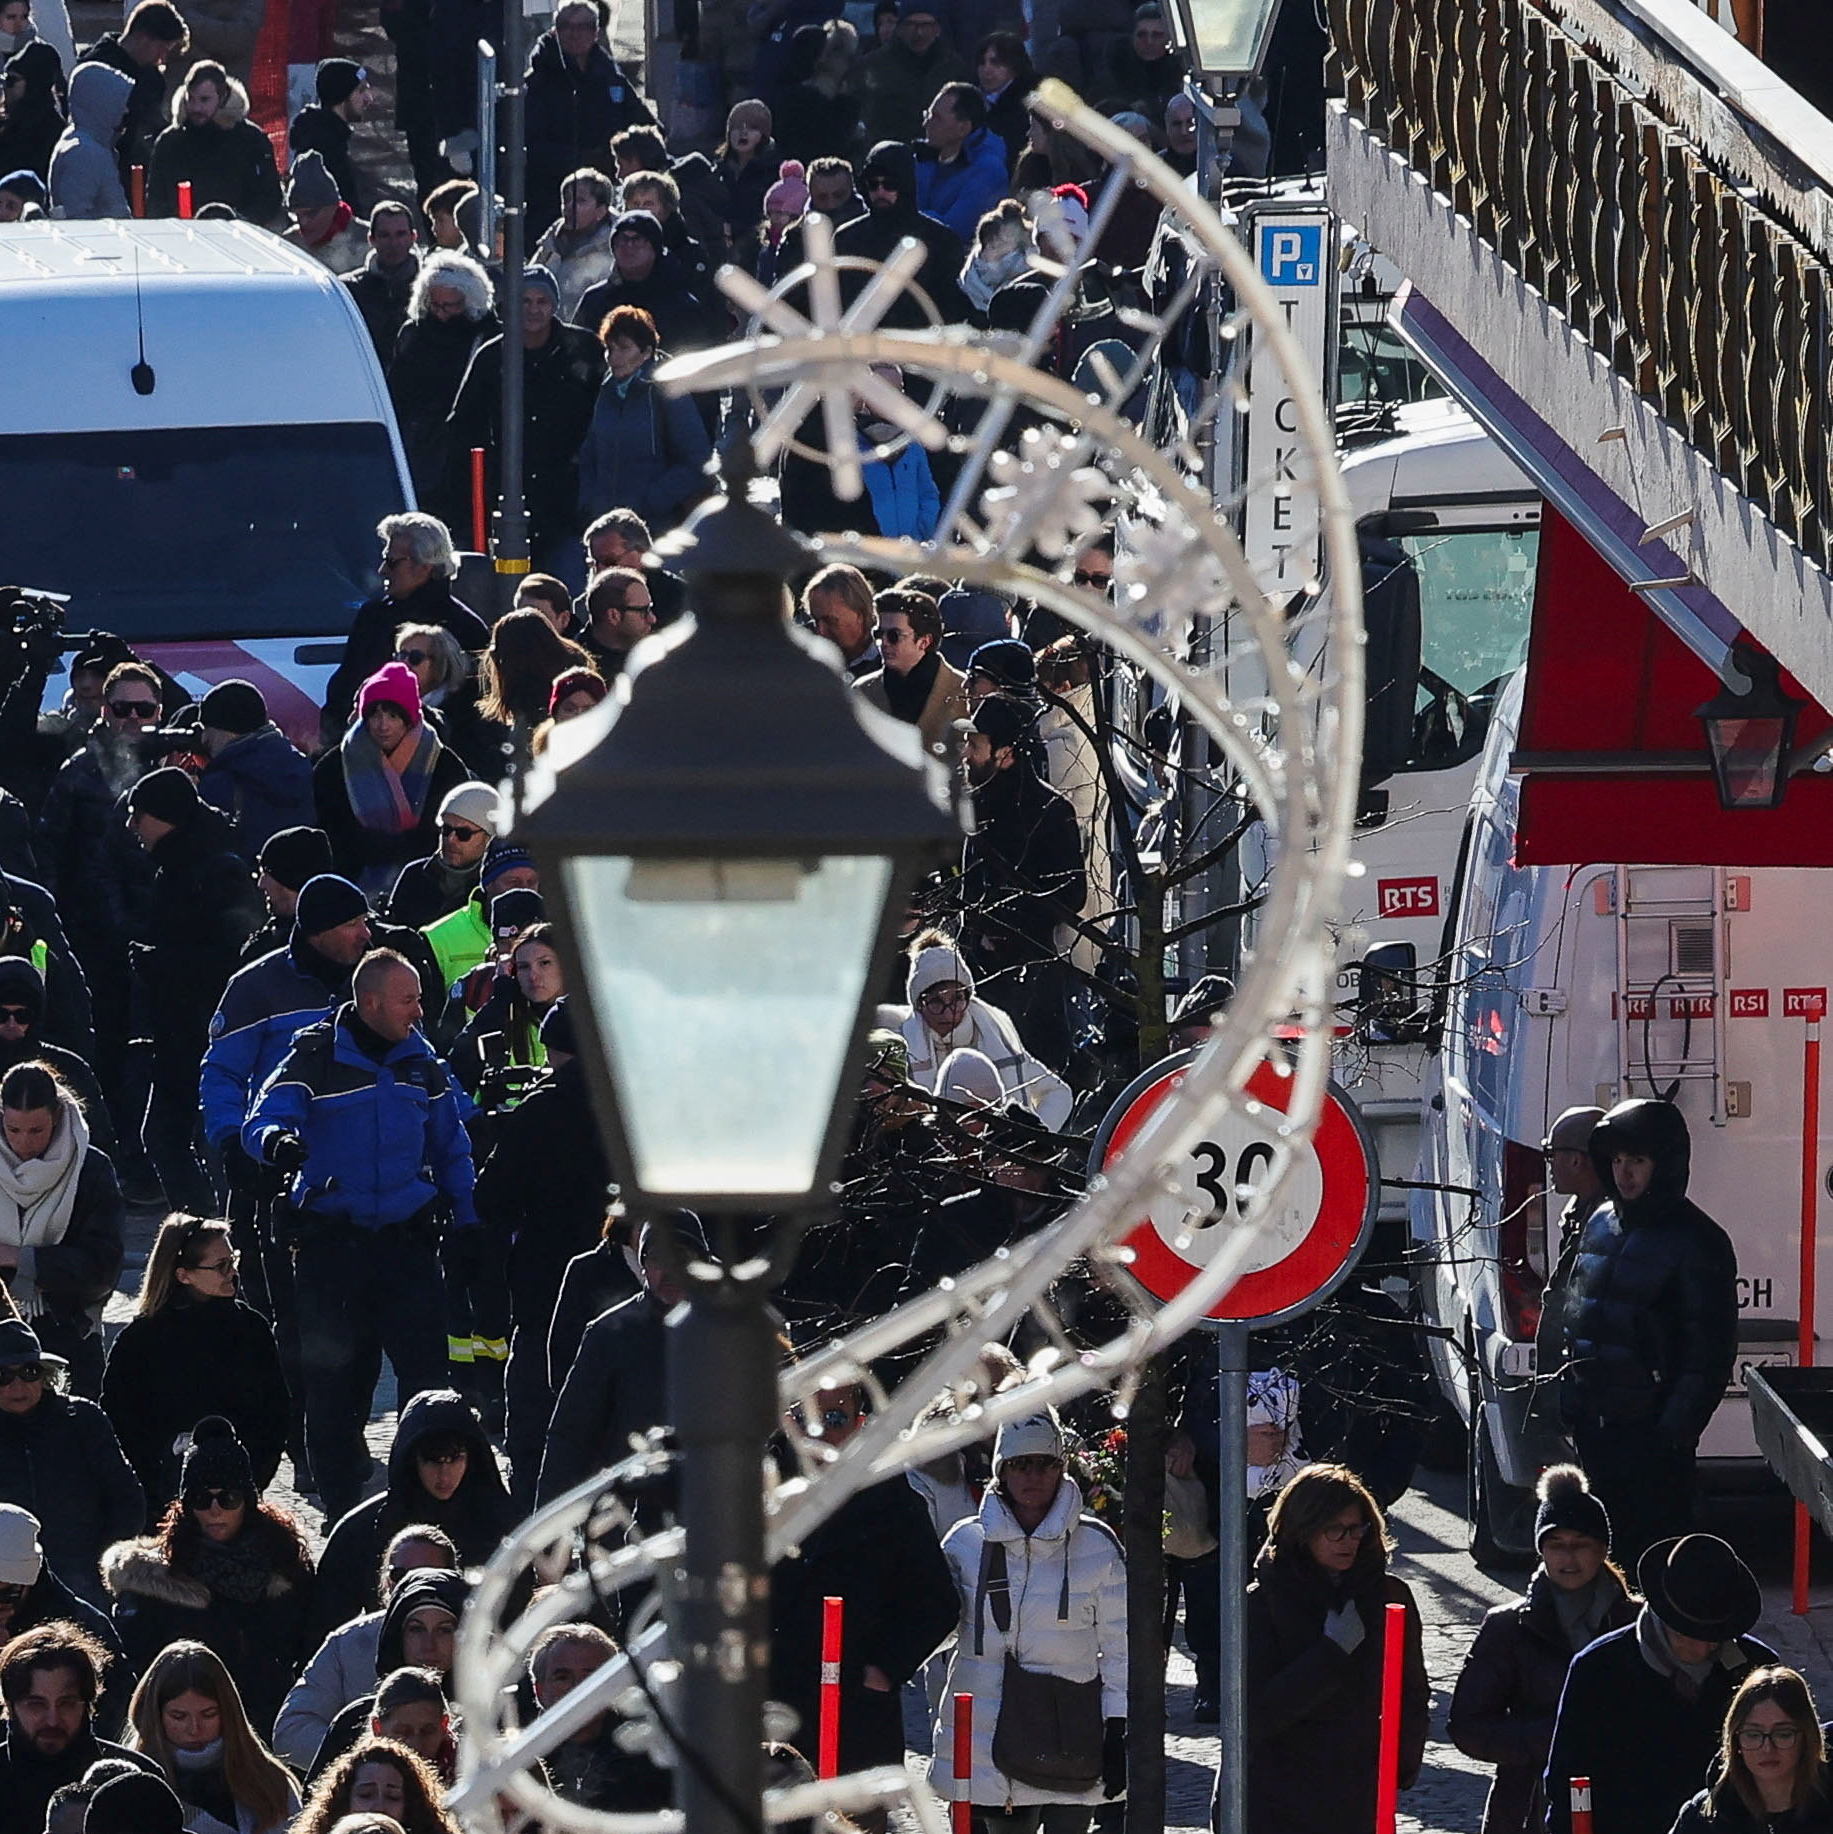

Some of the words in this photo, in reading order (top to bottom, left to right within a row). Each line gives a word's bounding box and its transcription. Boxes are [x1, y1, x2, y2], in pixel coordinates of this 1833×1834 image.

[1272, 232, 1301, 277] P
[1272, 301, 1299, 579] TCKET
[1385, 886, 1433, 908] RTS
[1734, 996, 1765, 1011] RSI
[1181, 1141, 1277, 1230] 30
